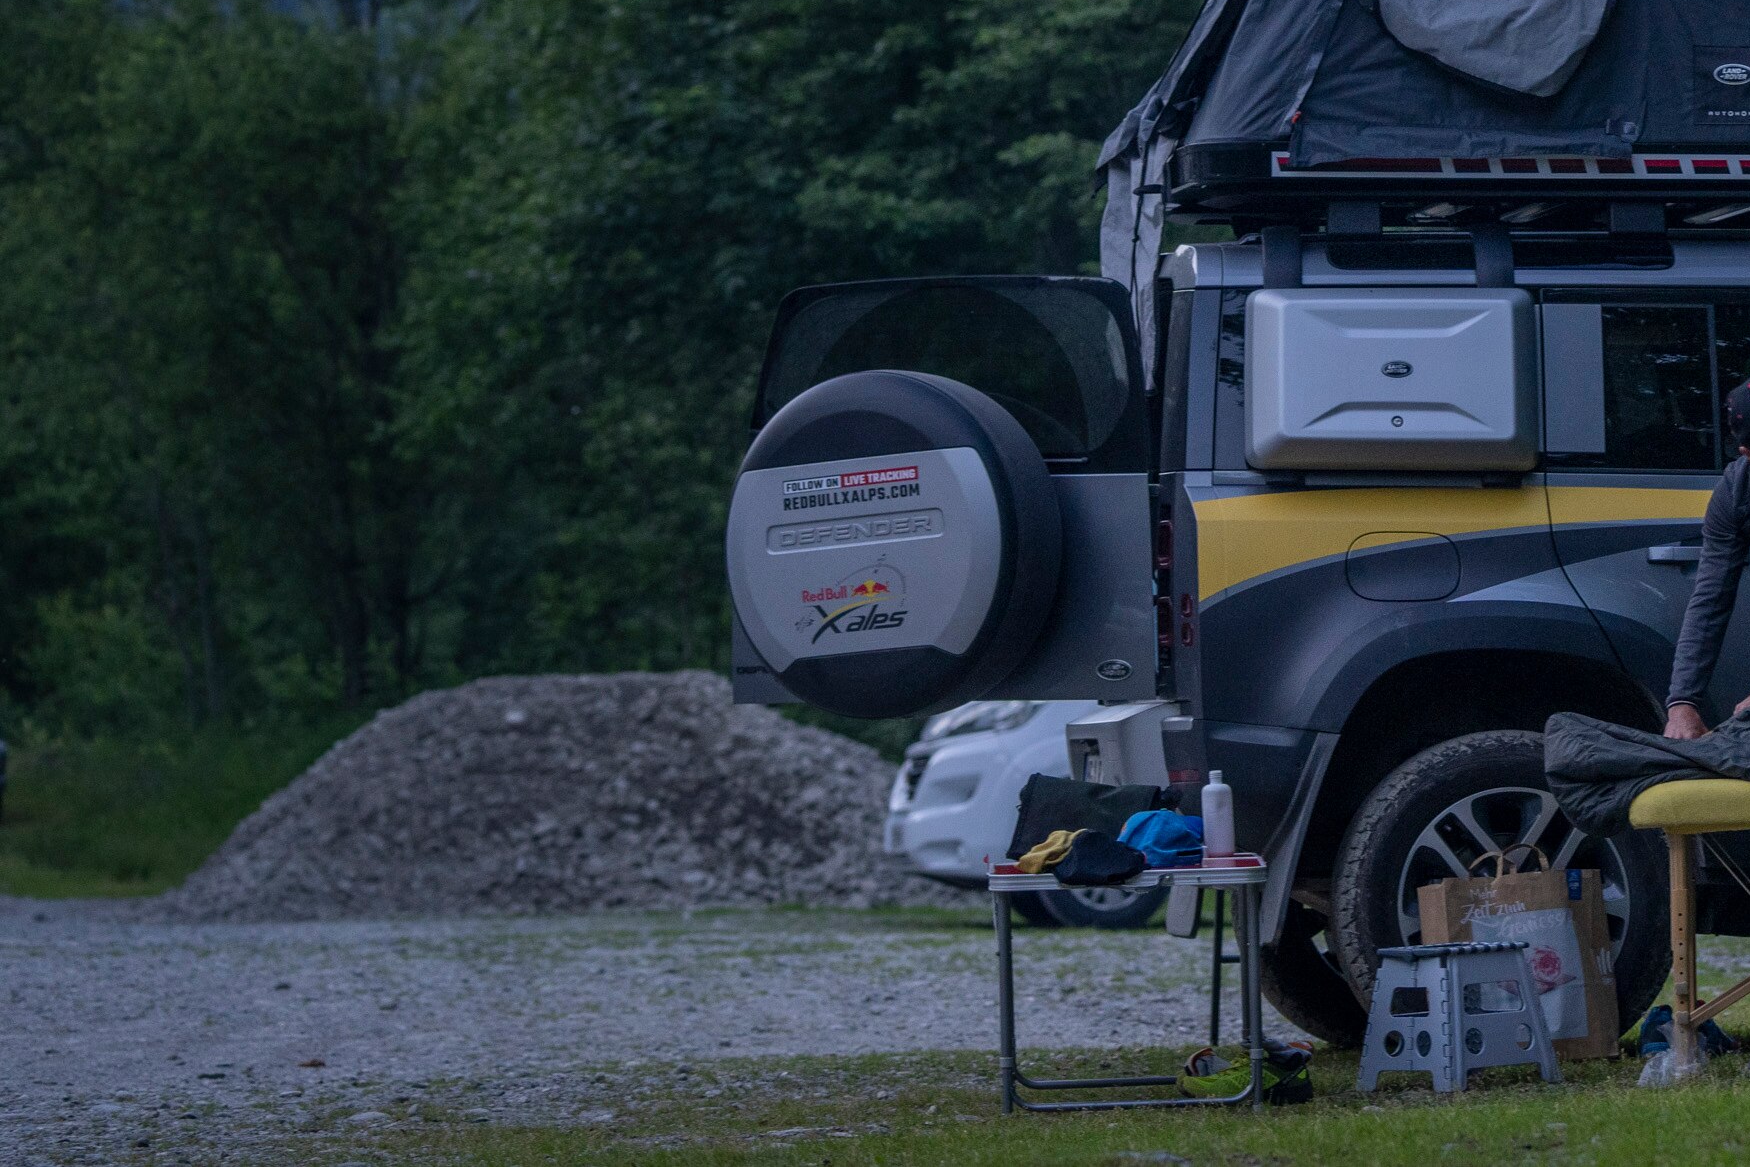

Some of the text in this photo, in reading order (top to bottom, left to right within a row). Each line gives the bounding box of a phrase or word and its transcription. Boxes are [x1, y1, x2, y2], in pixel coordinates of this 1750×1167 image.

[786, 469, 916, 492] FOLLOW ON LIVE TRACKING
[783, 483, 920, 511] REDBULLXALPS.COM
[780, 515, 932, 547] DEFENDER
[801, 586, 848, 603] Red Bull
